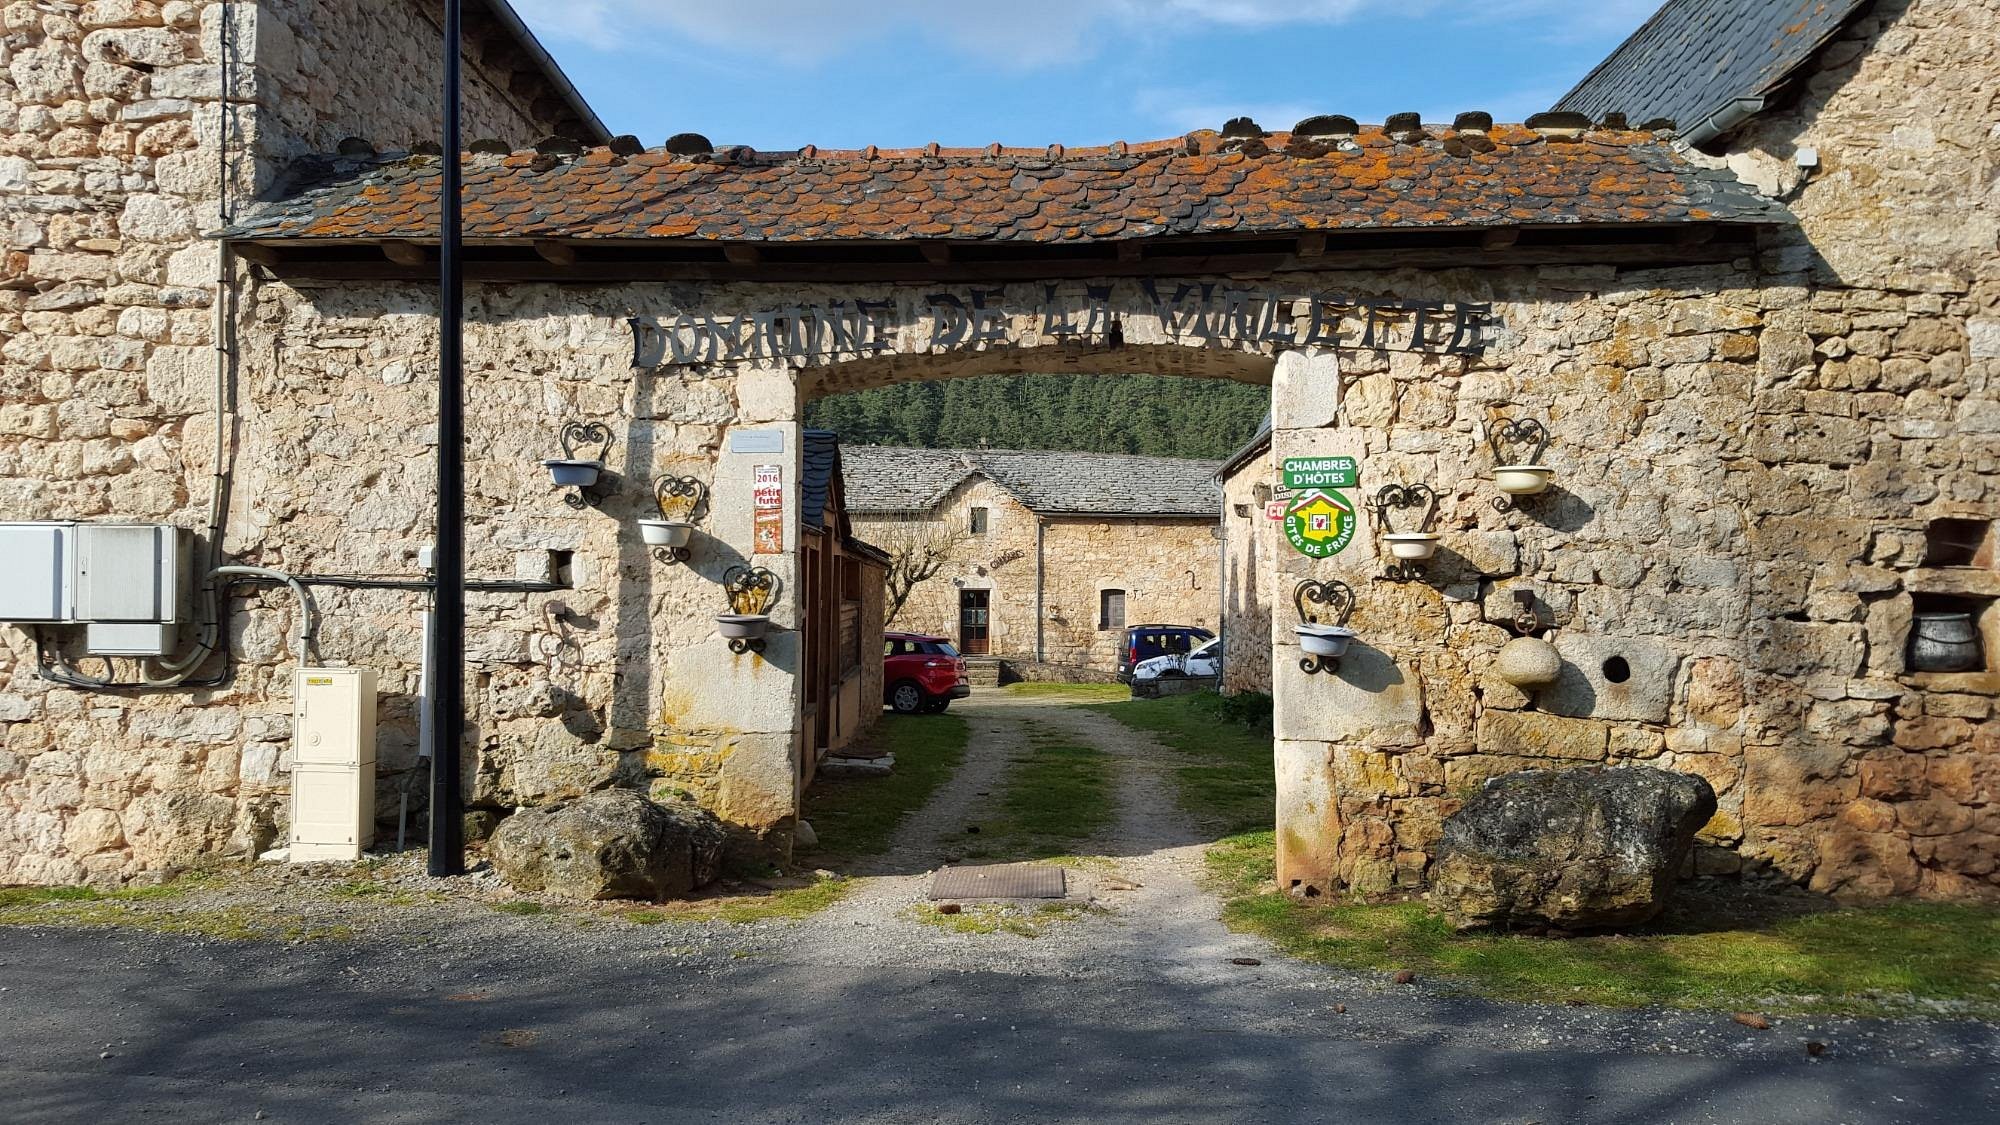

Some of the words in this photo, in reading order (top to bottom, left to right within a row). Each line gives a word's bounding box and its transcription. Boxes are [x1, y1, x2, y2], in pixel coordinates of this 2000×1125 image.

[627, 299, 889, 367] DOMAINE
[925, 287, 1005, 346] DE
[1044, 283, 1115, 335] LA
[1285, 459, 1352, 472] CHAMBRES
[757, 474, 778, 483] 2016
[1293, 472, 1345, 485] D'HÔTES
[1286, 516, 1304, 547] GITES
[1304, 543, 1321, 554] DE
[1326, 515, 1353, 553] FRANCE
